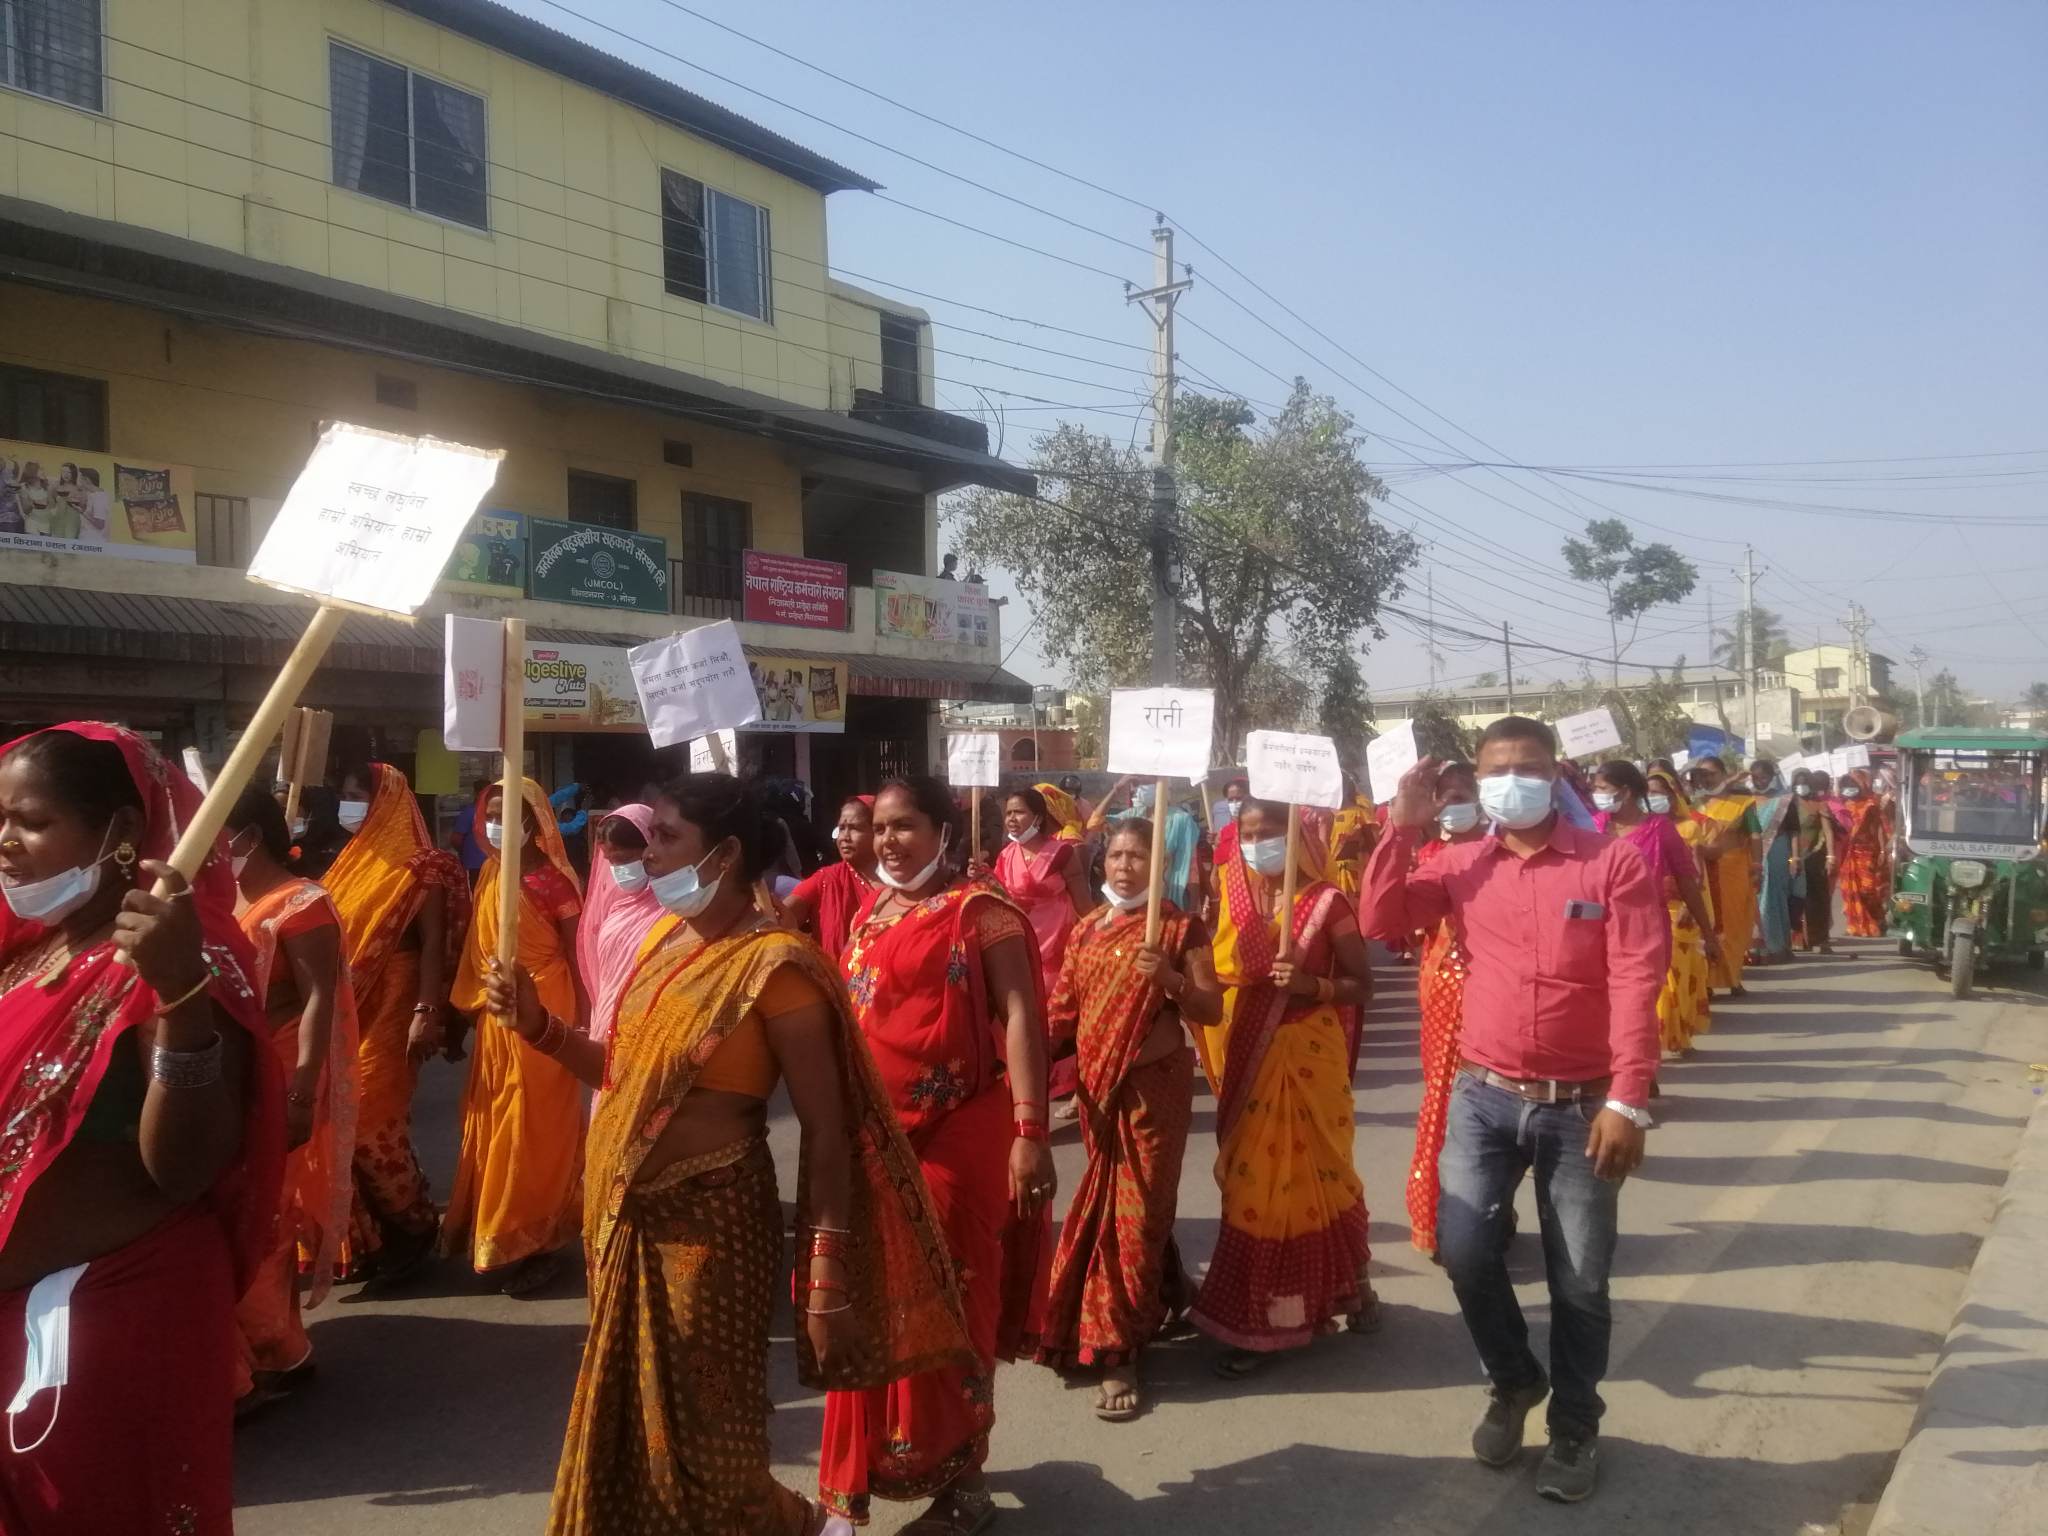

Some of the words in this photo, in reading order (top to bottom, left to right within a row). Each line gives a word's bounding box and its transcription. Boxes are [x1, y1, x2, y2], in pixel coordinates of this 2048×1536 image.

[401, 525, 433, 544] हाम्रो
[601, 532, 635, 555] सहकारी
[635, 547, 658, 575] संस्था
[583, 577, 624, 592] (JMCOL)
[745, 571, 770, 592] नेपाल
[794, 579, 823, 599] कर्मचारी
[524, 656, 587, 683] igestive
[555, 678, 587, 695] Nuts
[1143, 699, 1184, 728] रानी
